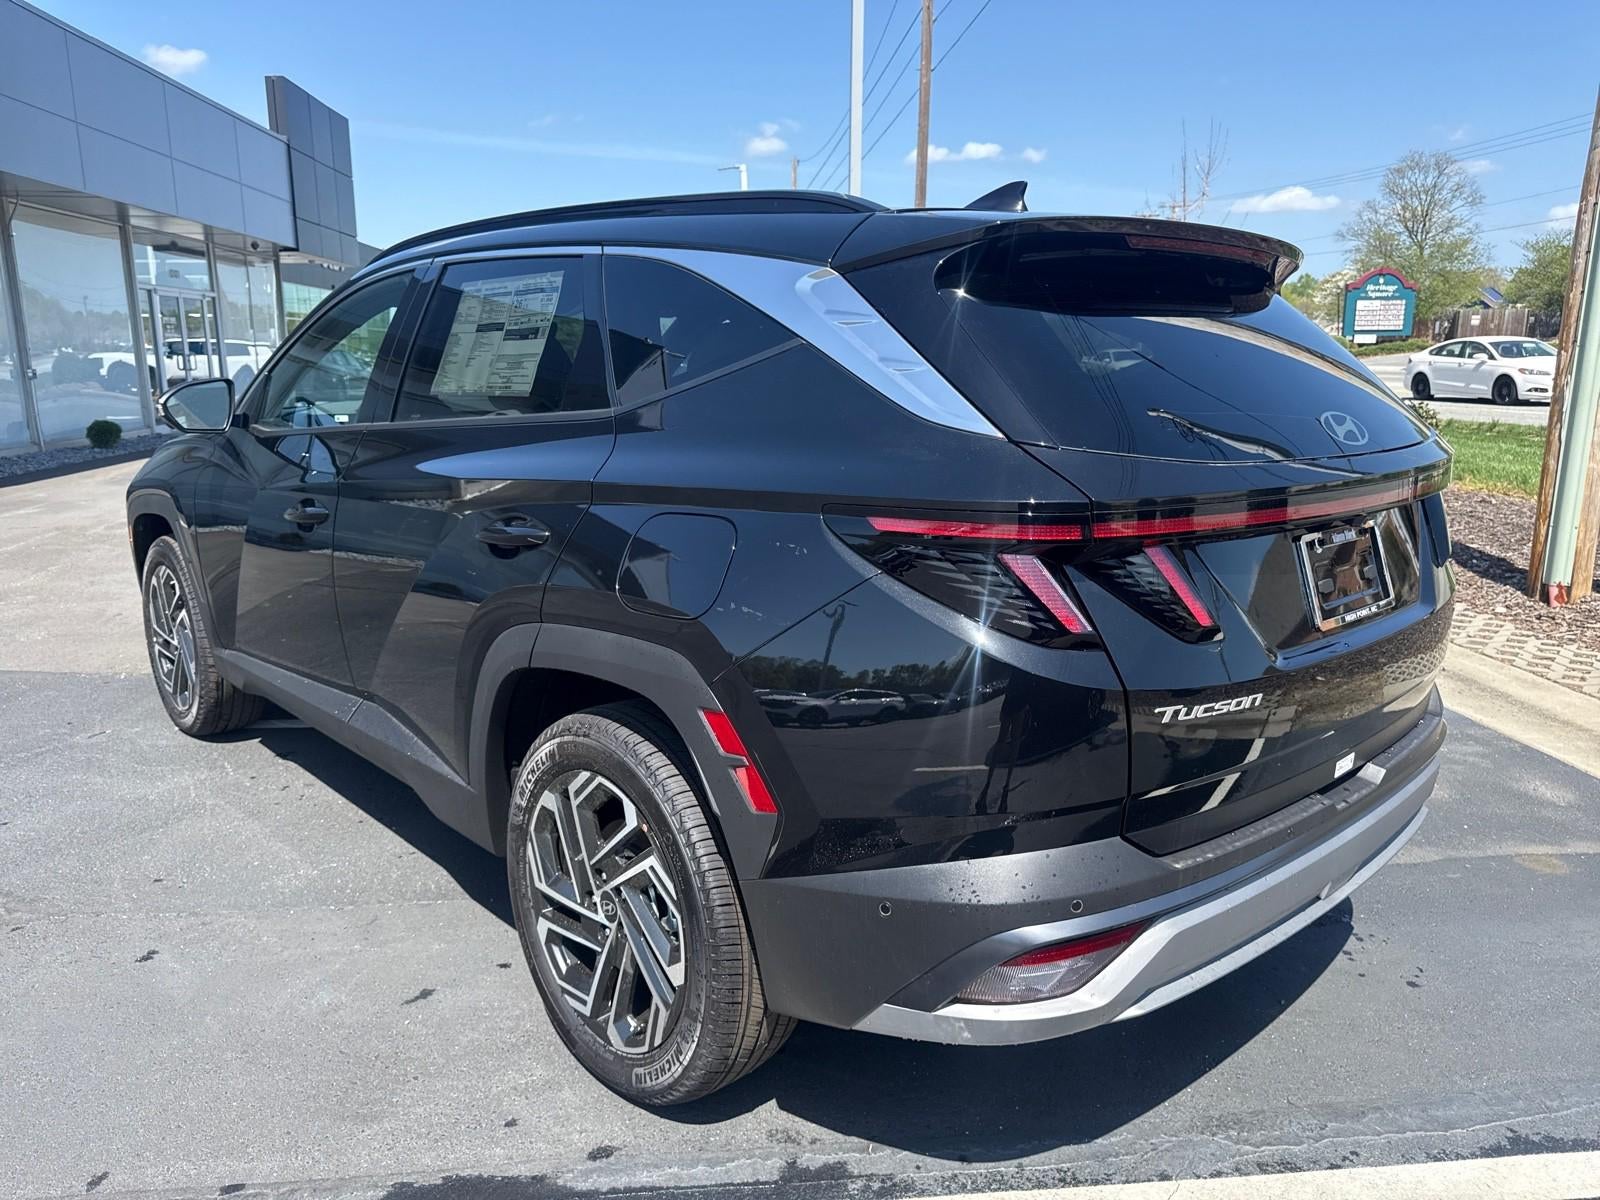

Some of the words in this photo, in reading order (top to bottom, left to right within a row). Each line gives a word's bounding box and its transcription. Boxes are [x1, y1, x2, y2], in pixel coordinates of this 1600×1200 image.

[1366, 284, 1398, 292] Heritage
[1368, 290, 1394, 298] Square
[1344, 612, 1357, 622] HIGH
[518, 743, 559, 803] MICHELIN
[634, 1040, 684, 1086] MICHELIN
